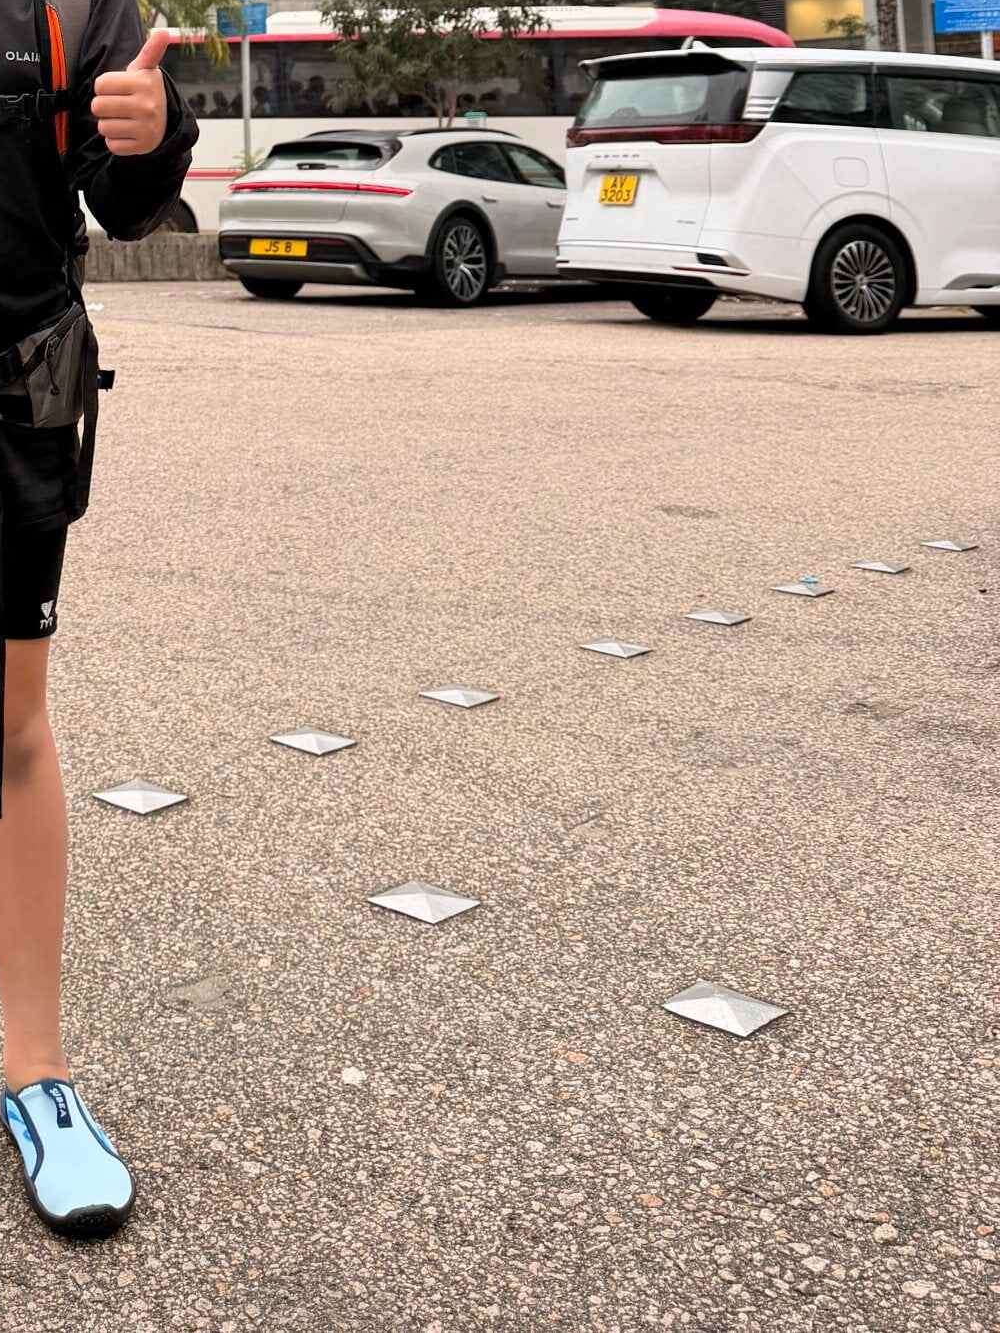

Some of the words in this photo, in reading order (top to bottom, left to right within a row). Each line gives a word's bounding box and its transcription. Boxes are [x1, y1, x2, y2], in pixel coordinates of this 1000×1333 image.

[5, 50, 41, 63] OLAIA
[611, 176, 628, 188] AV
[600, 189, 632, 202] 3203
[264, 240, 280, 252] JS
[284, 241, 292, 253] 8
